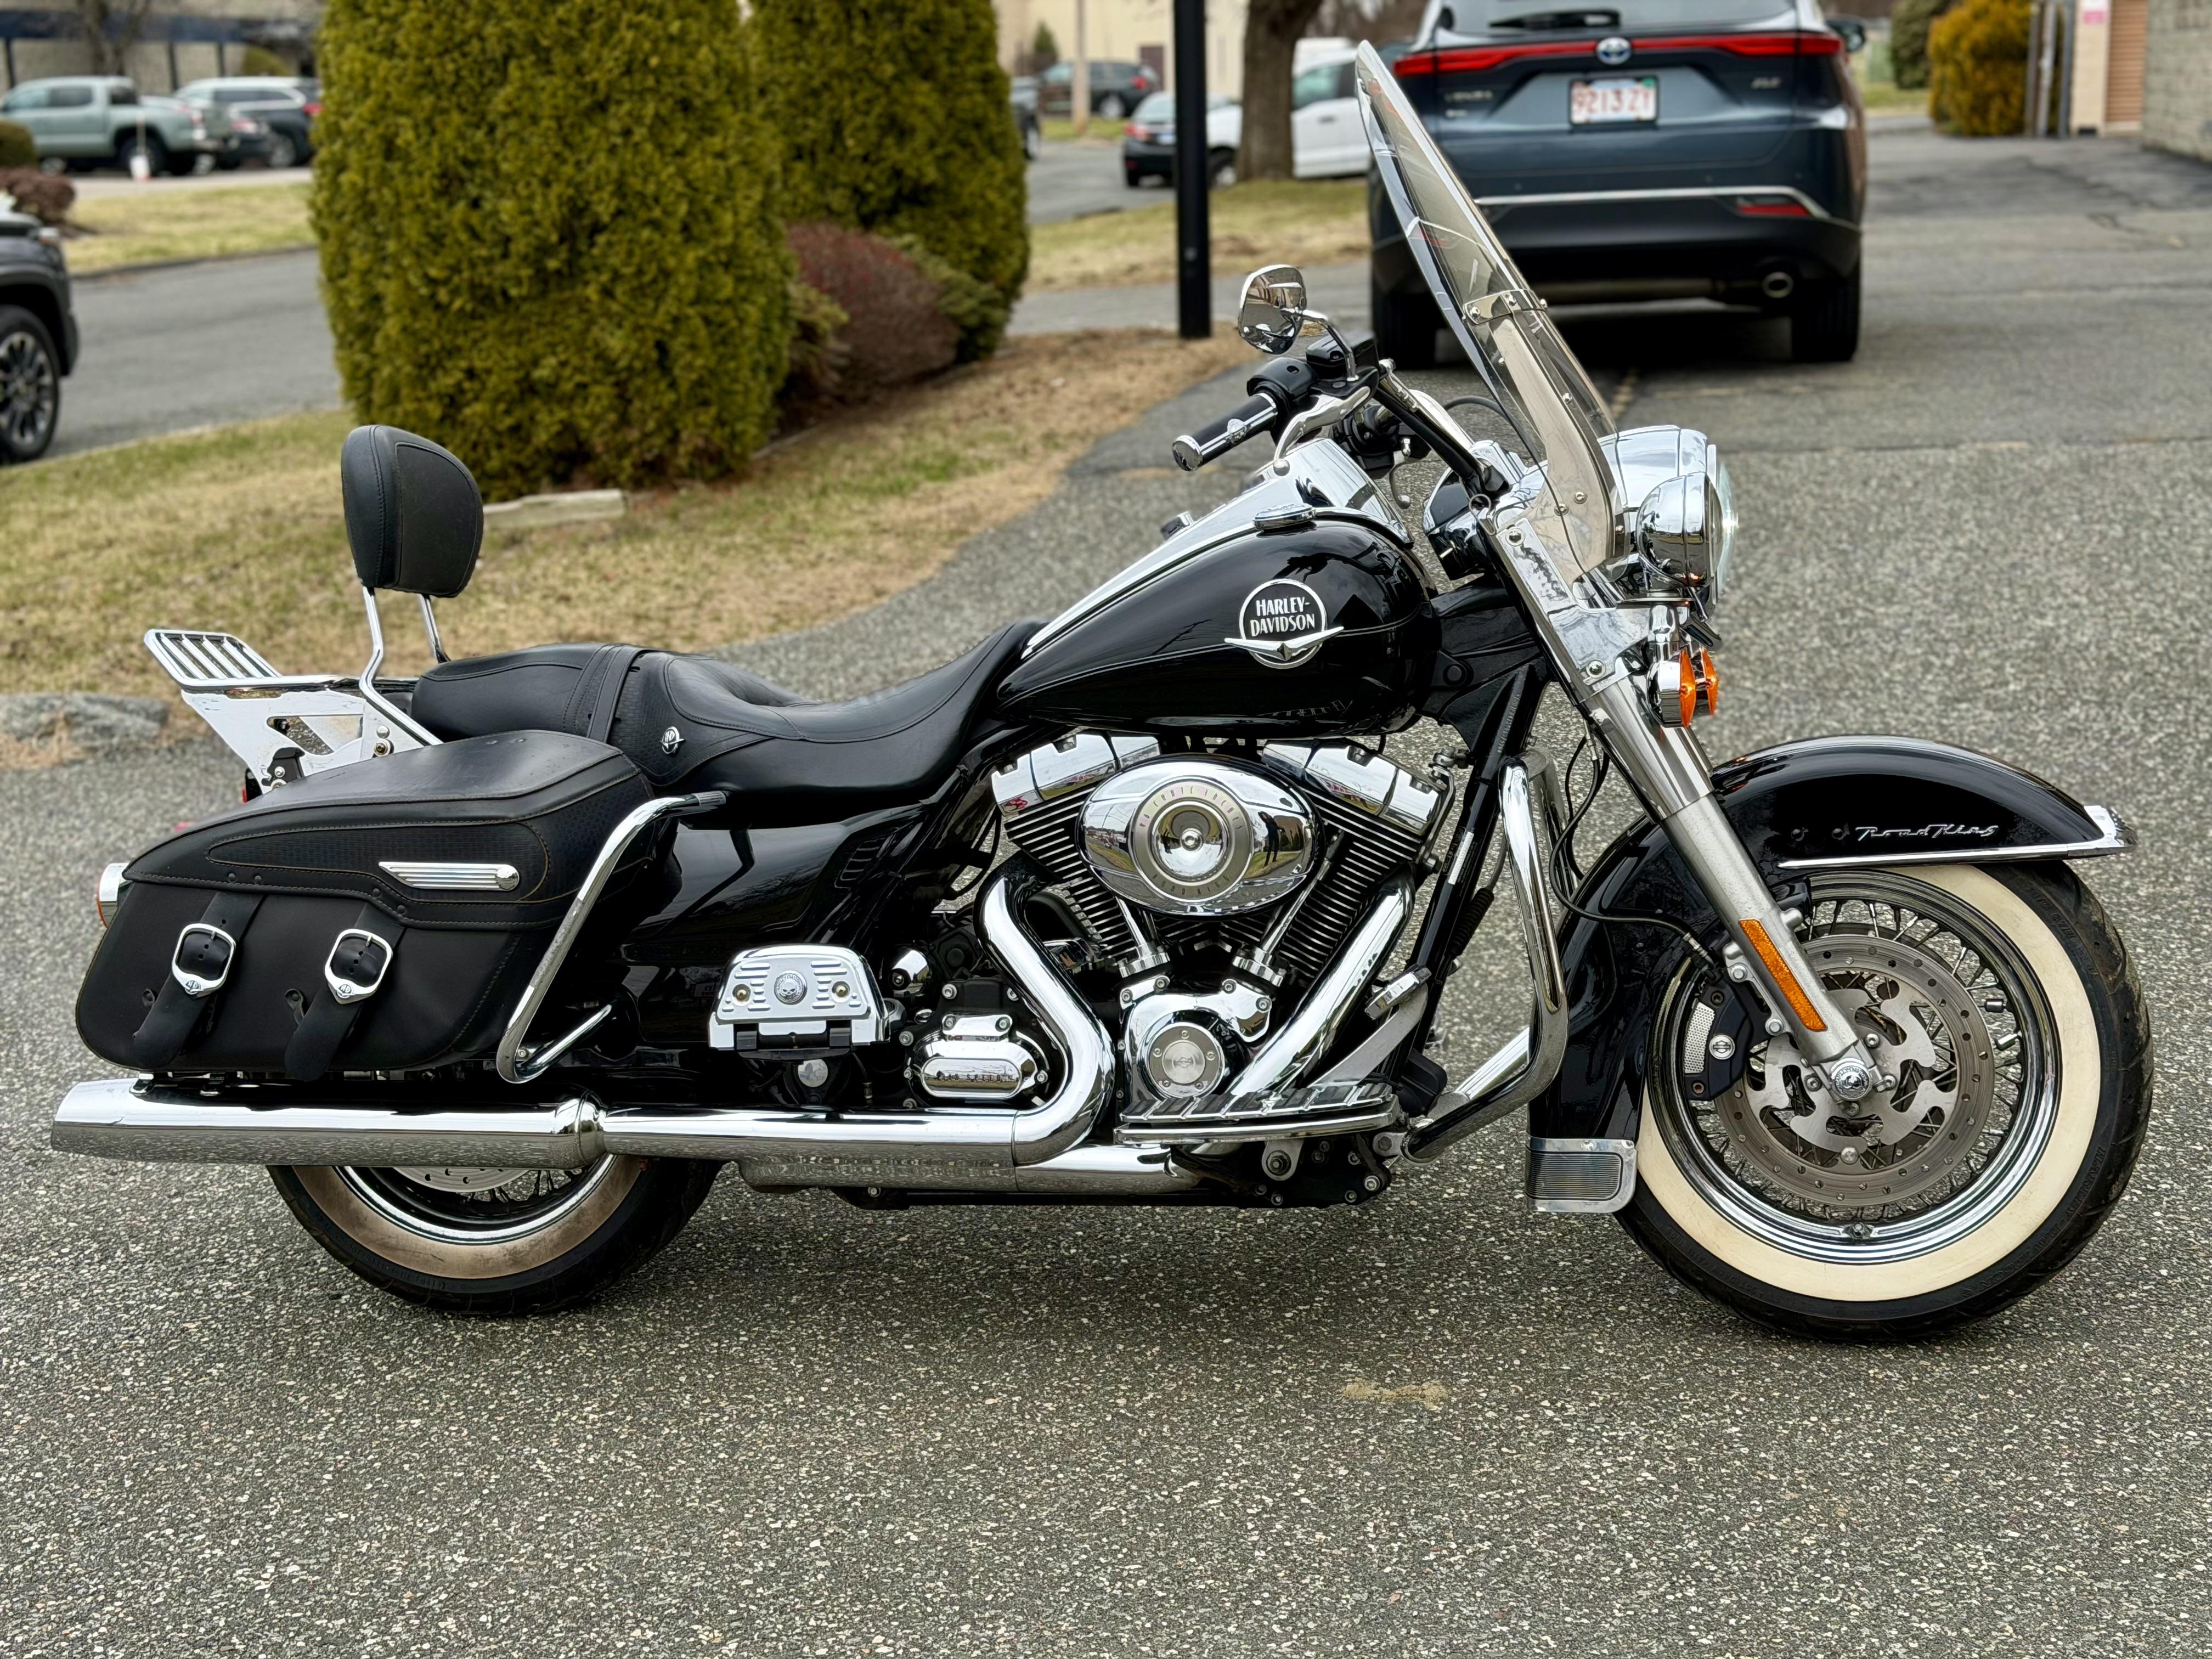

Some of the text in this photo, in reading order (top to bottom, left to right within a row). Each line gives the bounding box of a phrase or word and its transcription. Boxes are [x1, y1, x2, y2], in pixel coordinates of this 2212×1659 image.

[1256, 596, 1310, 617] HARLEY-
[1250, 613, 1316, 637] DAVIDSON
[1153, 786, 1194, 807] CUBIC
[1204, 788, 1244, 830] INCHES
